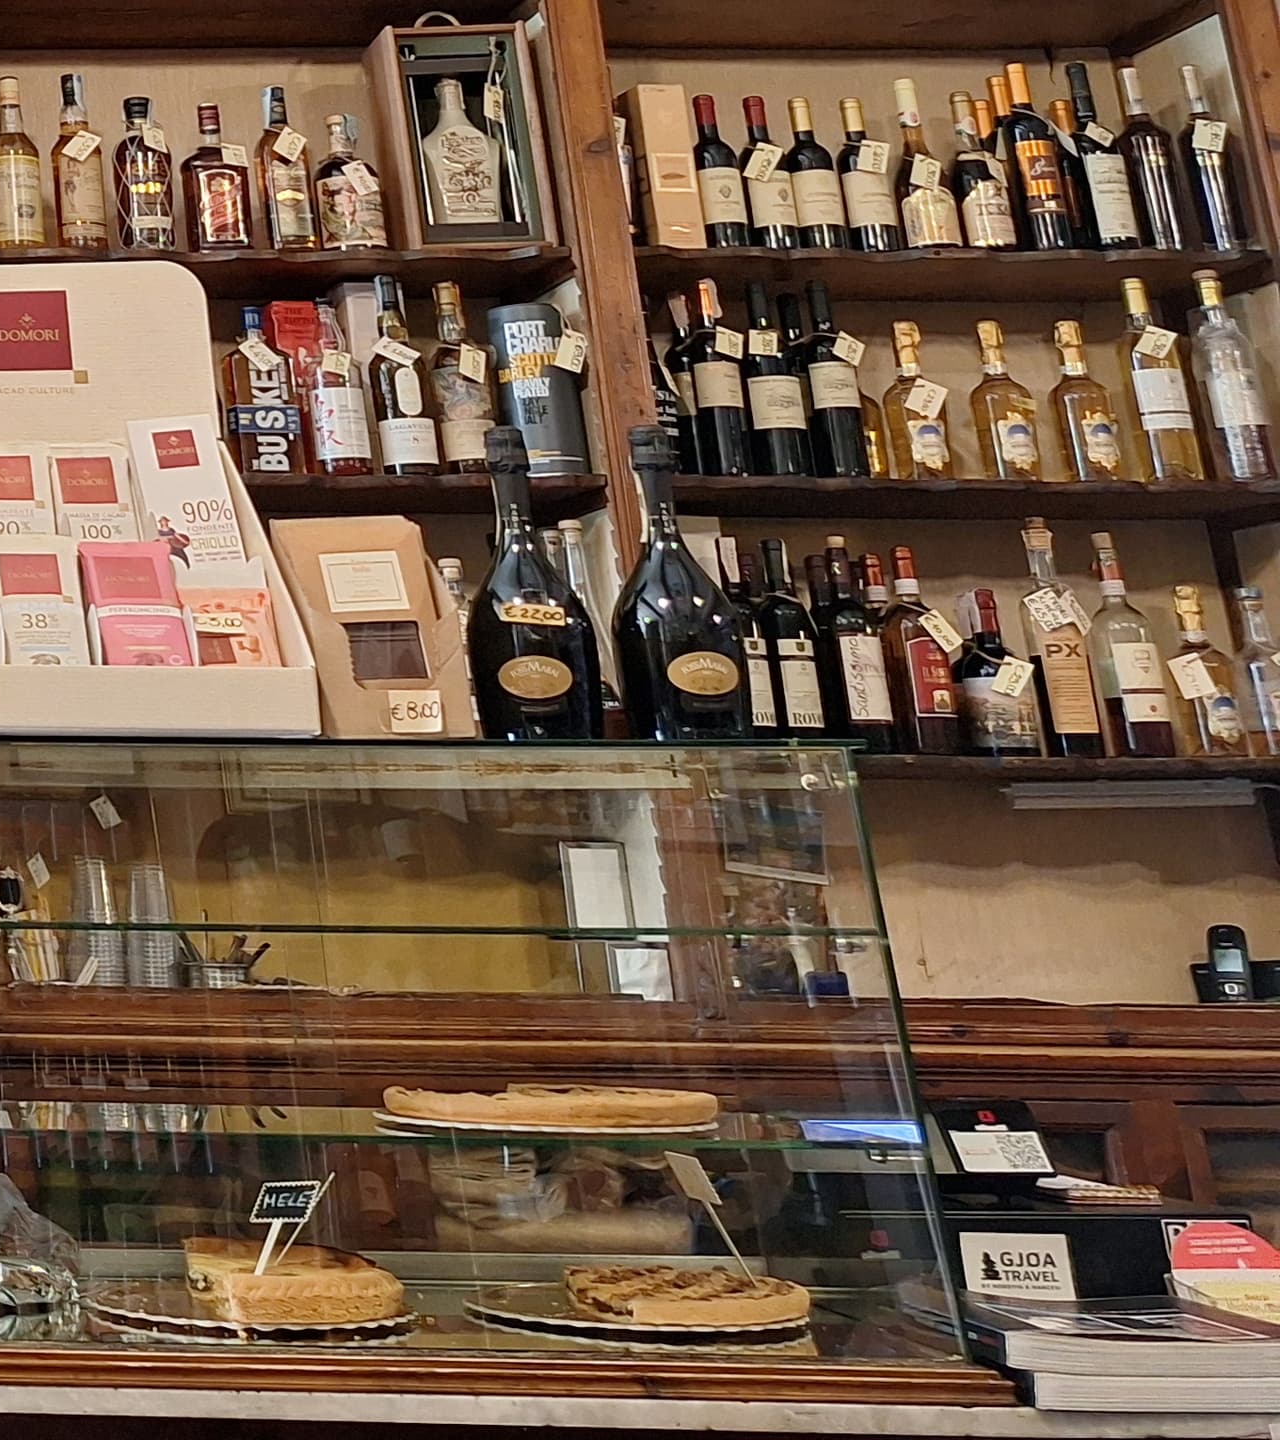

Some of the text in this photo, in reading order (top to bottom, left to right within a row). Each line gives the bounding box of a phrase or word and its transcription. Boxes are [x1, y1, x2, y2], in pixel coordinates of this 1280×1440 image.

[504, 320, 547, 338] PORT
[28, 386, 76, 395] CULTURE
[182, 499, 233, 524] 90%
[191, 534, 238, 551] CRIOLLO
[503, 607, 563, 623] €22,00
[1044, 643, 1082, 659] PX
[391, 700, 439, 721] €8,00
[263, 1190, 317, 1210] MELE
[1000, 1251, 1057, 1268] GJOA
[1001, 1270, 1060, 1283] TRAVEL
